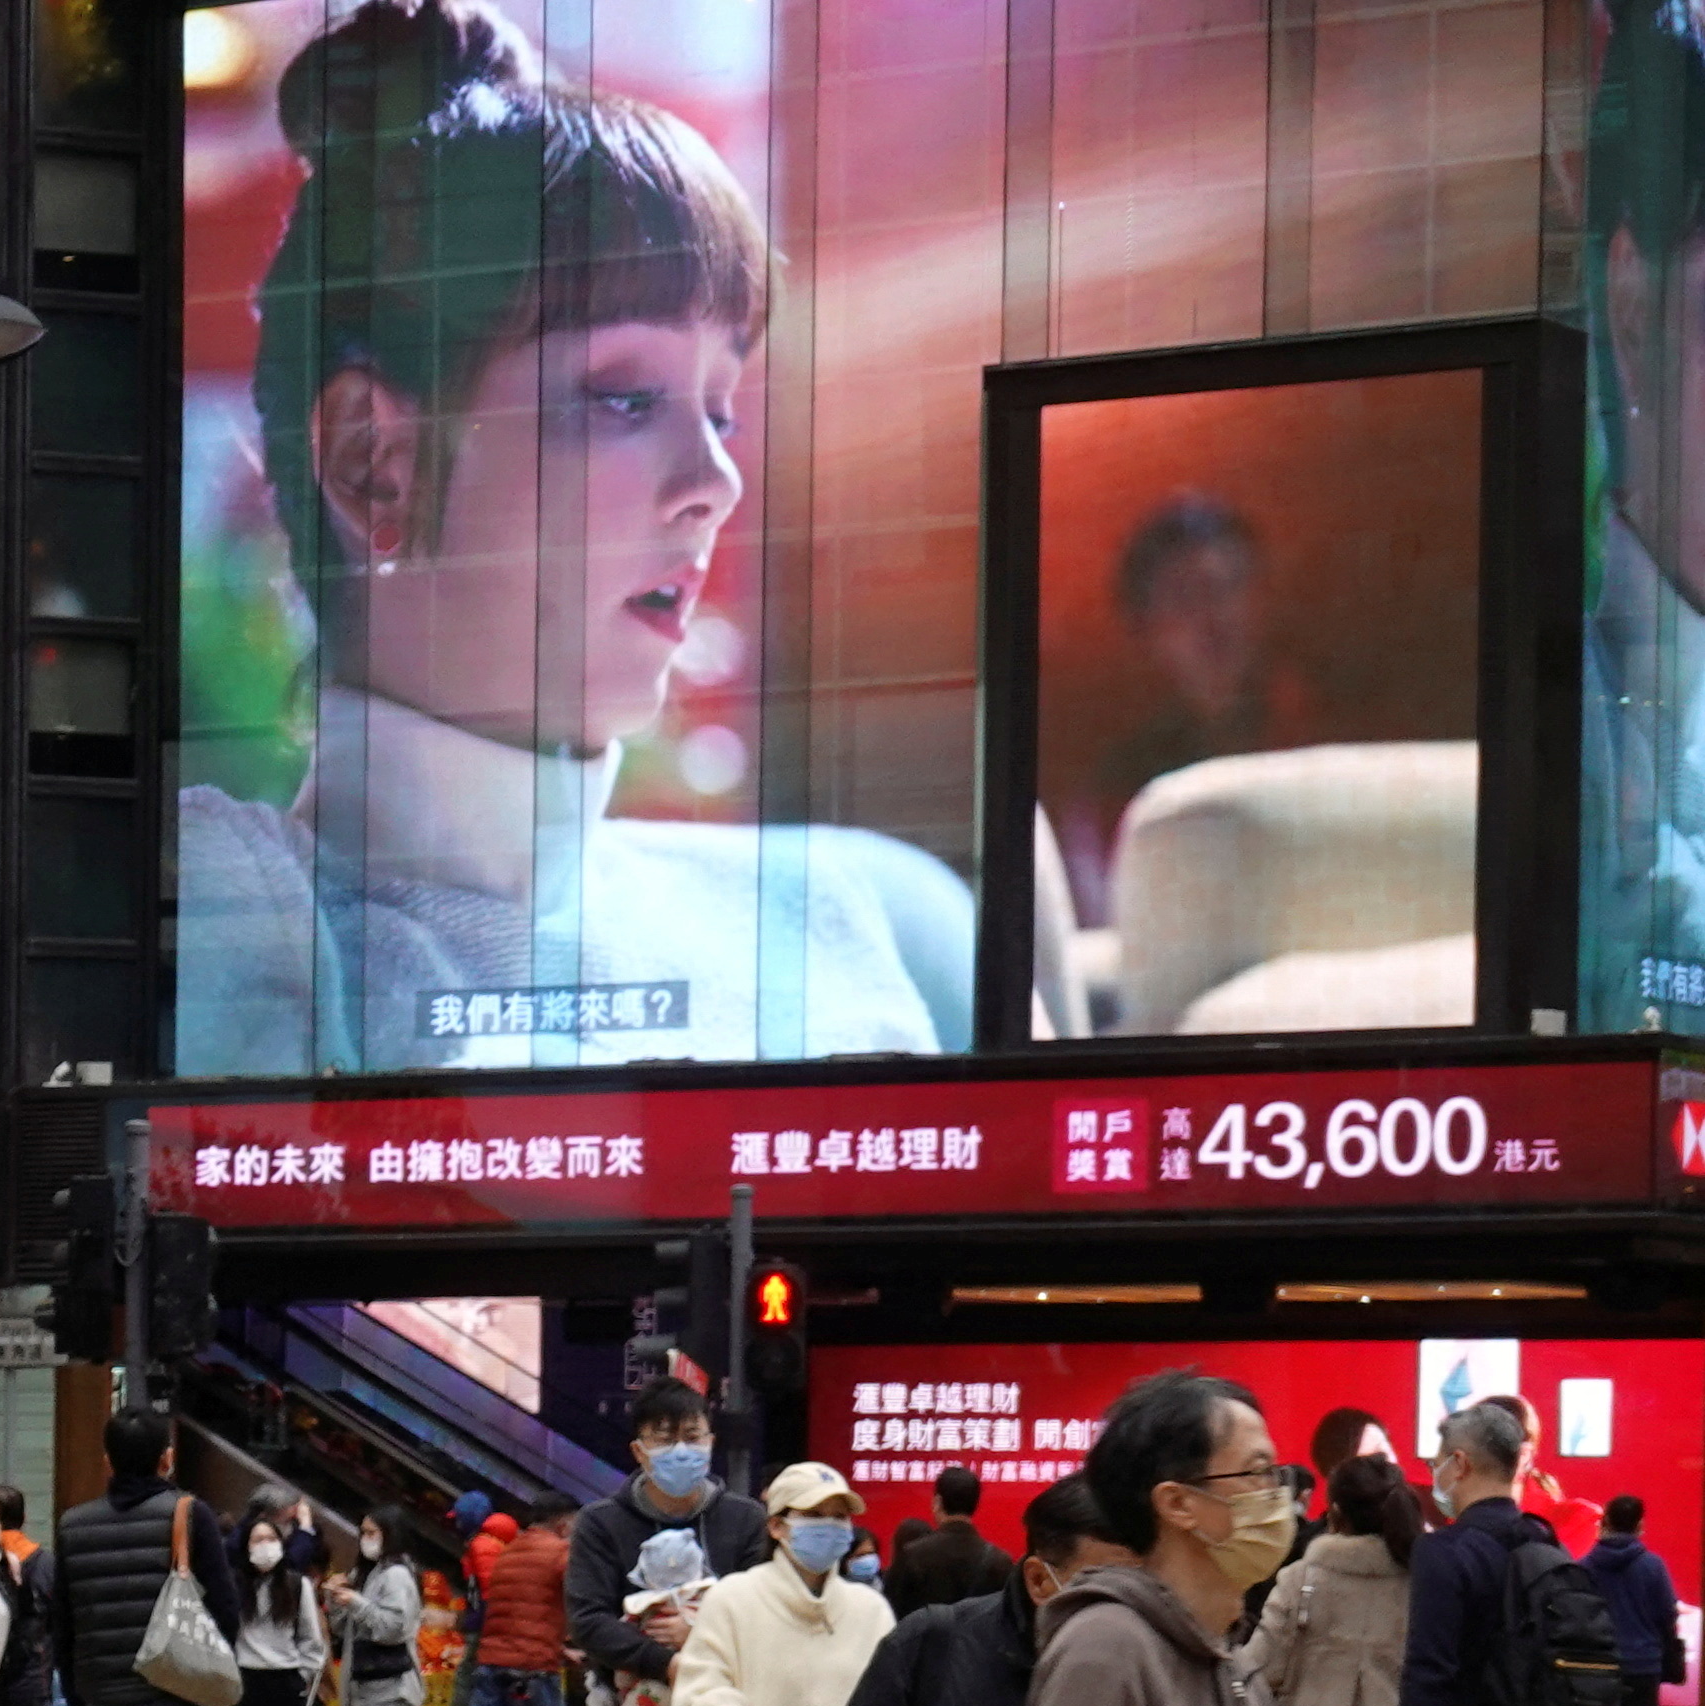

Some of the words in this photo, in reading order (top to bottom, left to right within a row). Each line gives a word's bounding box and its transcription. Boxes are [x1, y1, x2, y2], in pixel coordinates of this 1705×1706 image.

[1197, 1095, 1488, 1190] 43,600
[1493, 1138, 1562, 1173] 港元
[194, 1142, 347, 1188] 家的未來
[368, 1134, 645, 1183] 由擁抱改變而來
[1066, 1148, 1133, 1182] 獎賞
[851, 1417, 1021, 1451] 度身財富策劃
[1033, 1418, 1109, 1451] 開創
